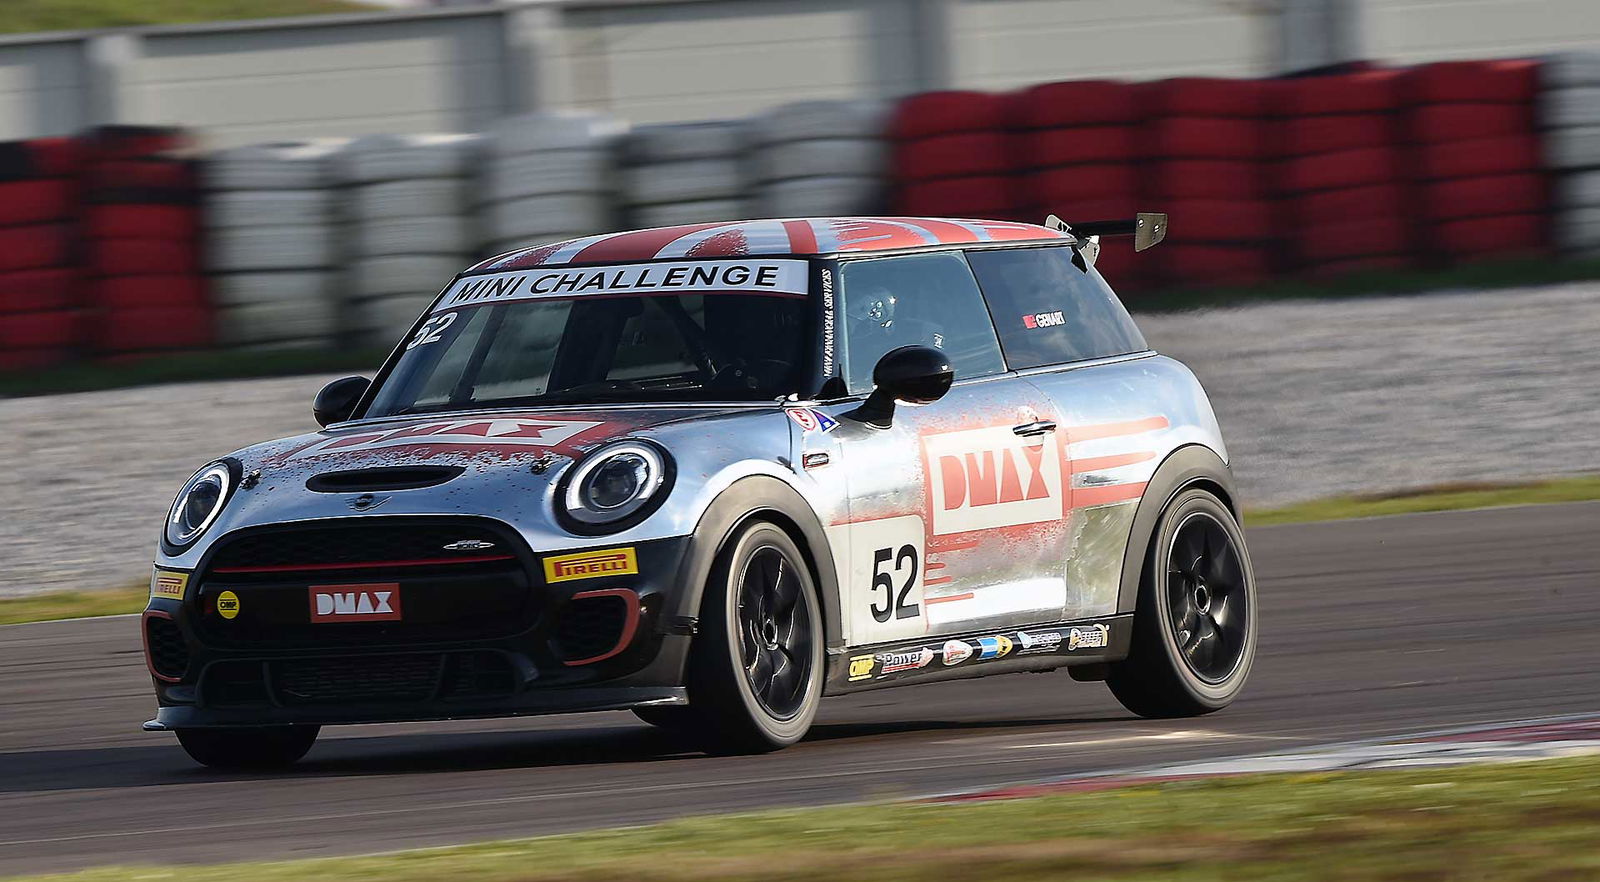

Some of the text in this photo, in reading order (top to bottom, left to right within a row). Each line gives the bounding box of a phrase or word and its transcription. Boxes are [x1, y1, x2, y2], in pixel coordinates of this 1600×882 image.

[451, 265, 779, 304] MINI CHALLENGE
[406, 311, 458, 350] 52
[939, 445, 1050, 511] DMAX
[553, 554, 627, 578] PIRELLI
[870, 543, 920, 622] 52
[316, 591, 394, 615] DMAX
